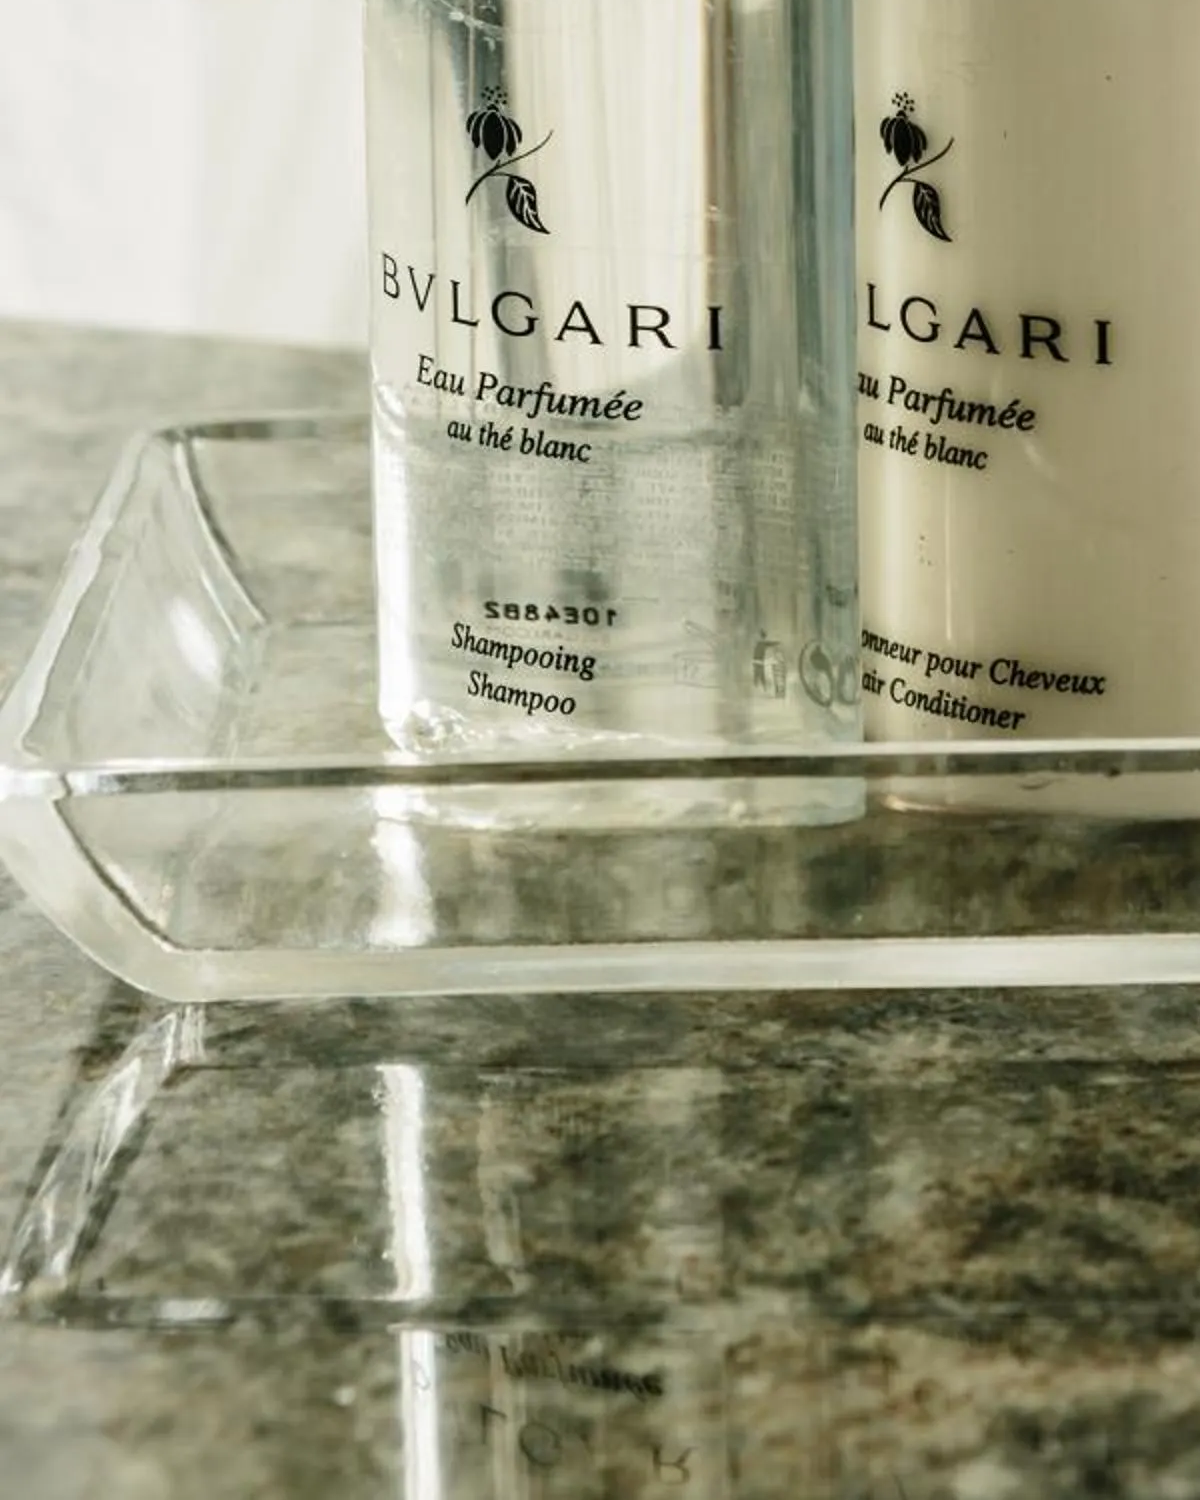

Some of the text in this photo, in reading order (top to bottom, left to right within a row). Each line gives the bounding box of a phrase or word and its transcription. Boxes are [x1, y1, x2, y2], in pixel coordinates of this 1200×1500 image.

[382, 252, 723, 351] BVLGARI
[867, 282, 1113, 365] LGARI
[416, 354, 644, 421] Eau Parfumée
[887, 375, 1036, 432] Parfumée
[447, 420, 592, 464] au thé blanc
[864, 423, 989, 471] au thé blanc
[451, 622, 597, 681] Shampooing
[925, 651, 983, 679] pour
[989, 657, 1107, 696] Cheveux
[467, 670, 576, 717] Shampoo
[890, 677, 1026, 732] Conditioner
